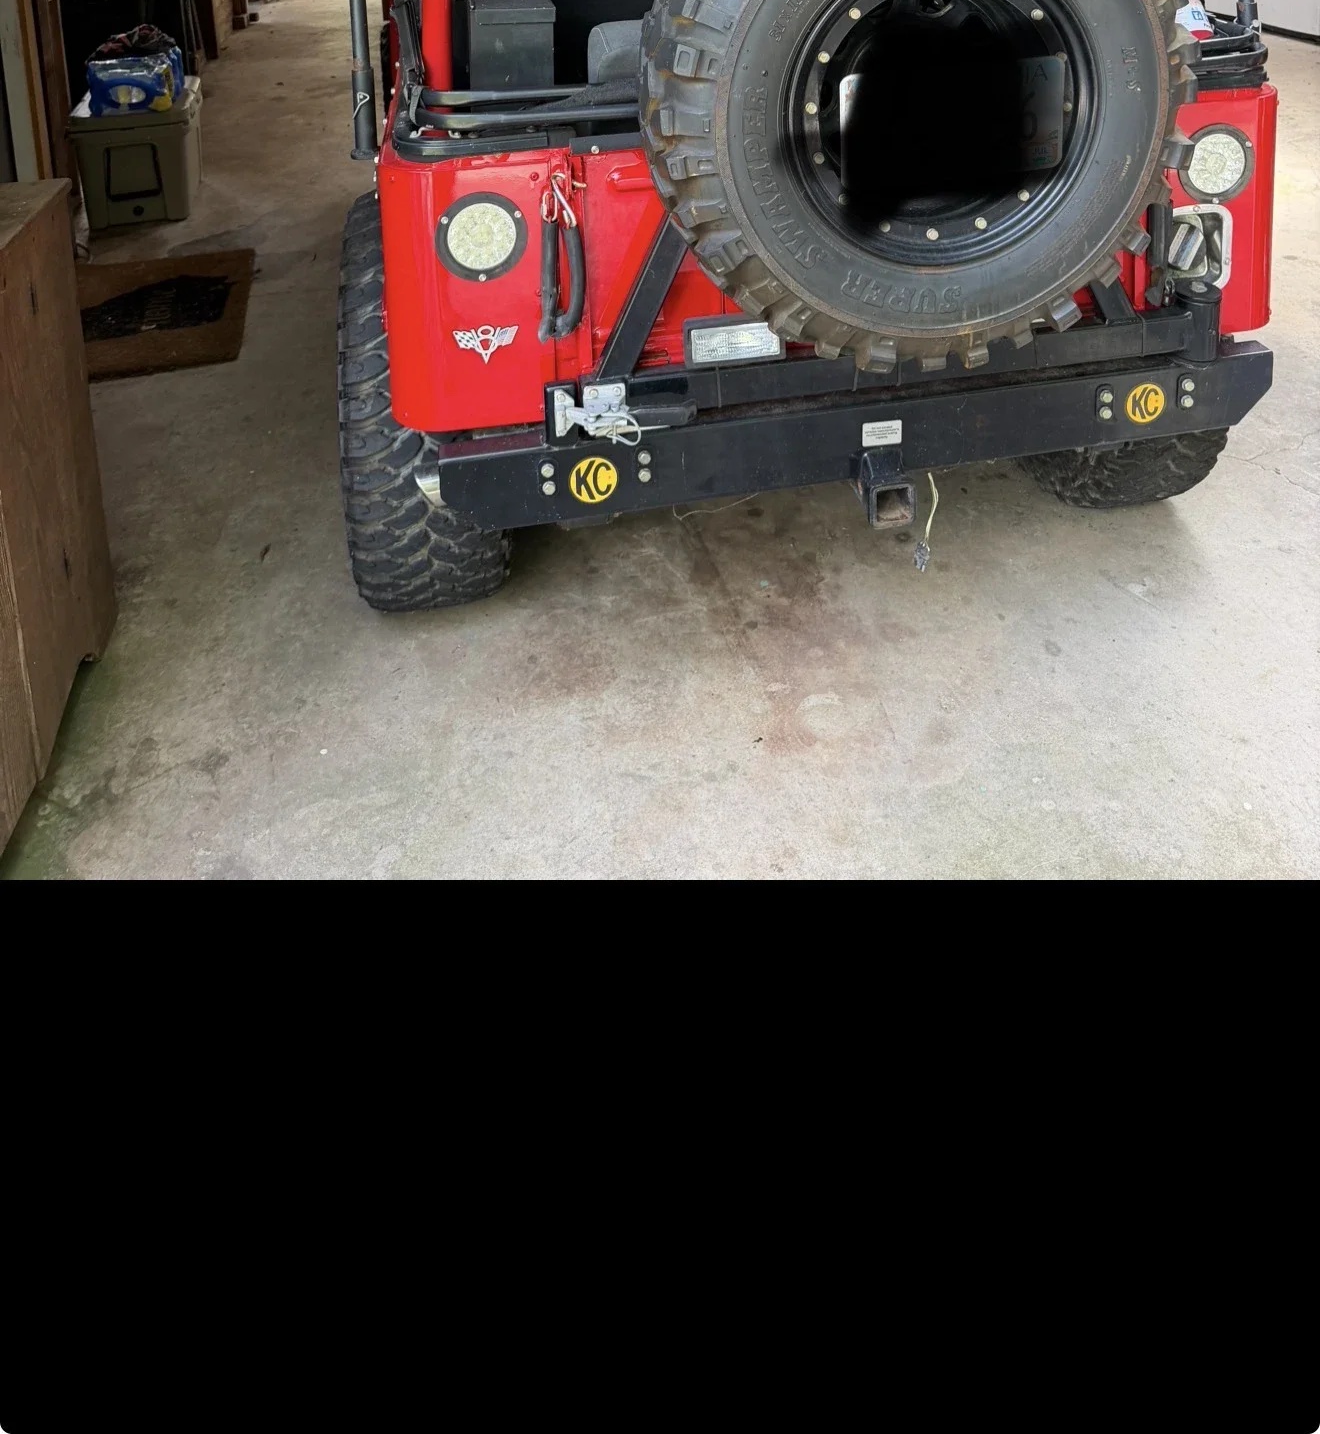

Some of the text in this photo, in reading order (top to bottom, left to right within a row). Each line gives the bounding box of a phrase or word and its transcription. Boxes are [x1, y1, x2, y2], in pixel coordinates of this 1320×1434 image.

[741, 85, 962, 315] SUPER SWAMPER
[1131, 386, 1160, 420] KC
[574, 459, 613, 501] KC
